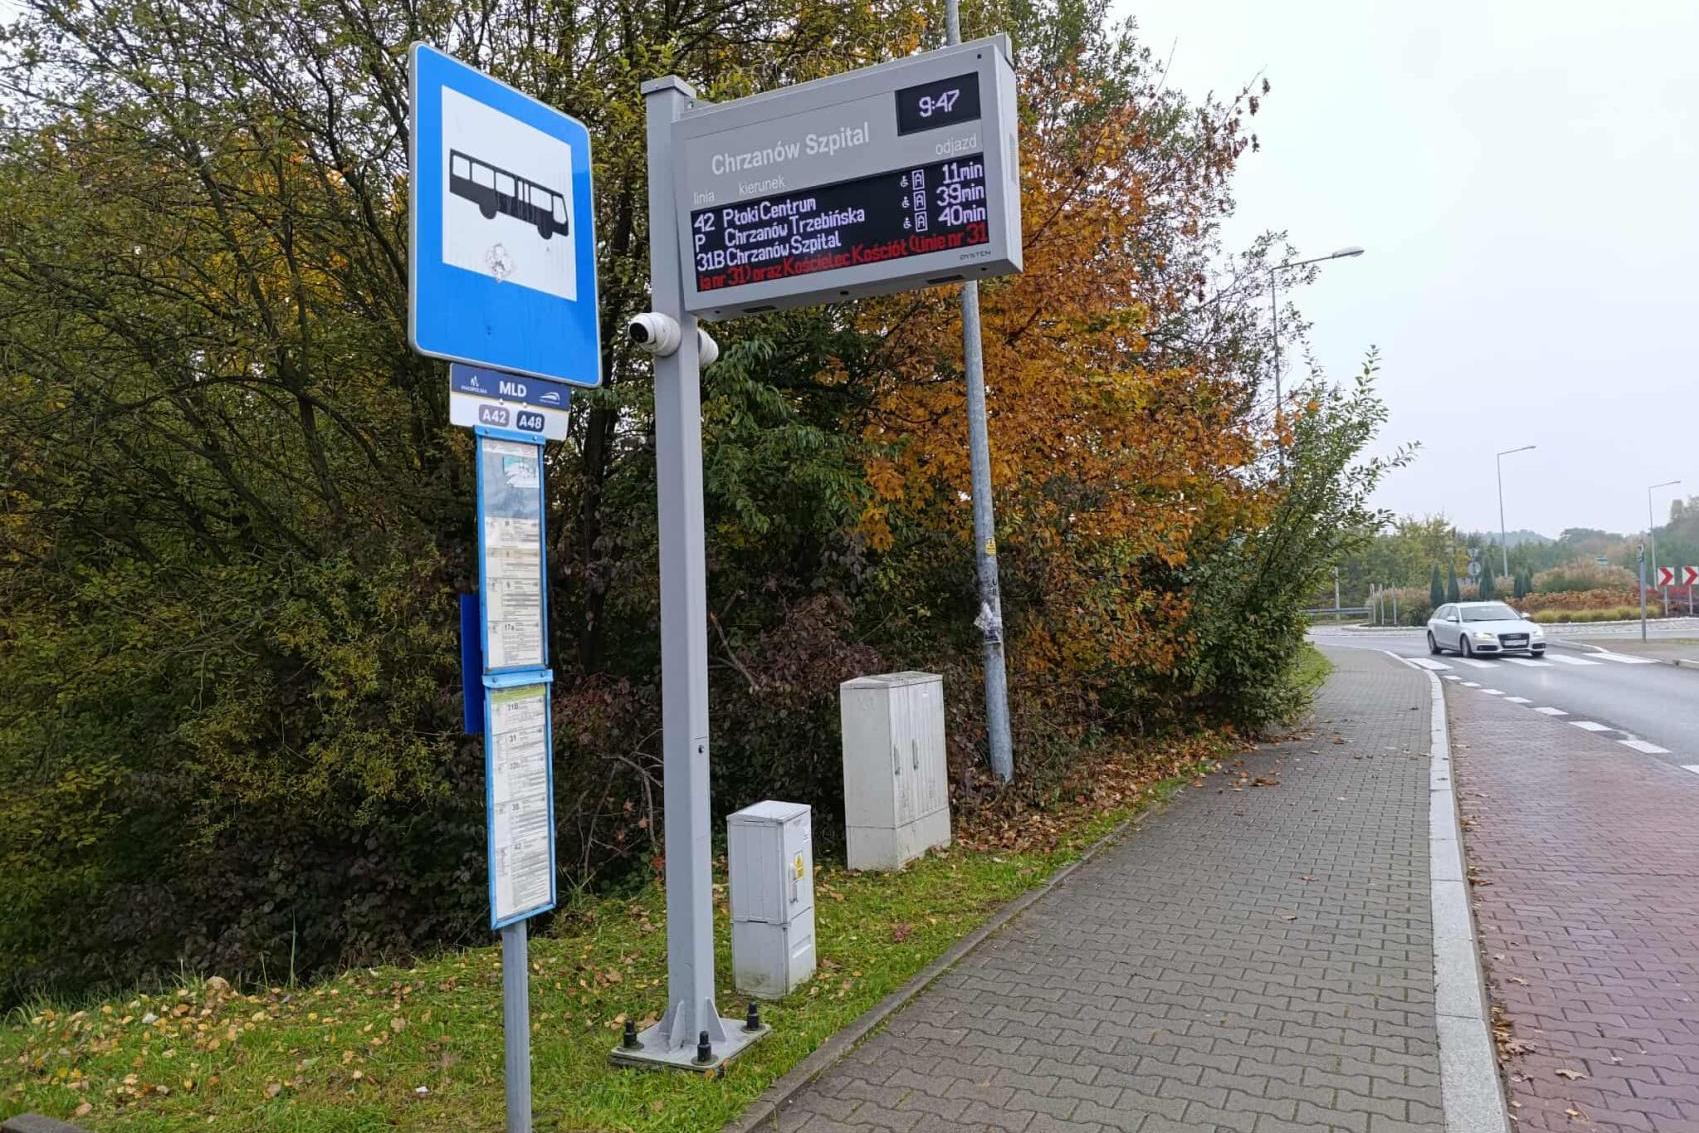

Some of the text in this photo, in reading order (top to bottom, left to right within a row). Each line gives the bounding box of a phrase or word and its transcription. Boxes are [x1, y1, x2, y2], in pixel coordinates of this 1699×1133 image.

[919, 89, 960, 118] 9:47
[711, 122, 870, 176] Chrzanów Szpital
[935, 133, 978, 156] odjazd
[693, 176, 786, 206] linia kierunek
[694, 212, 716, 233] 42
[760, 197, 816, 220] Centrum
[942, 162, 984, 184] 11min
[694, 234, 706, 253] P
[724, 222, 788, 247] Chrzanów
[789, 206, 865, 235] Trzebińska
[936, 183, 985, 207] 39min
[696, 250, 726, 272] 31B
[726, 242, 789, 268] Chrzanów
[790, 230, 842, 256] Szpital
[938, 204, 986, 227] 40min
[499, 380, 527, 398] MLD
[482, 408, 542, 430] A42 A48
